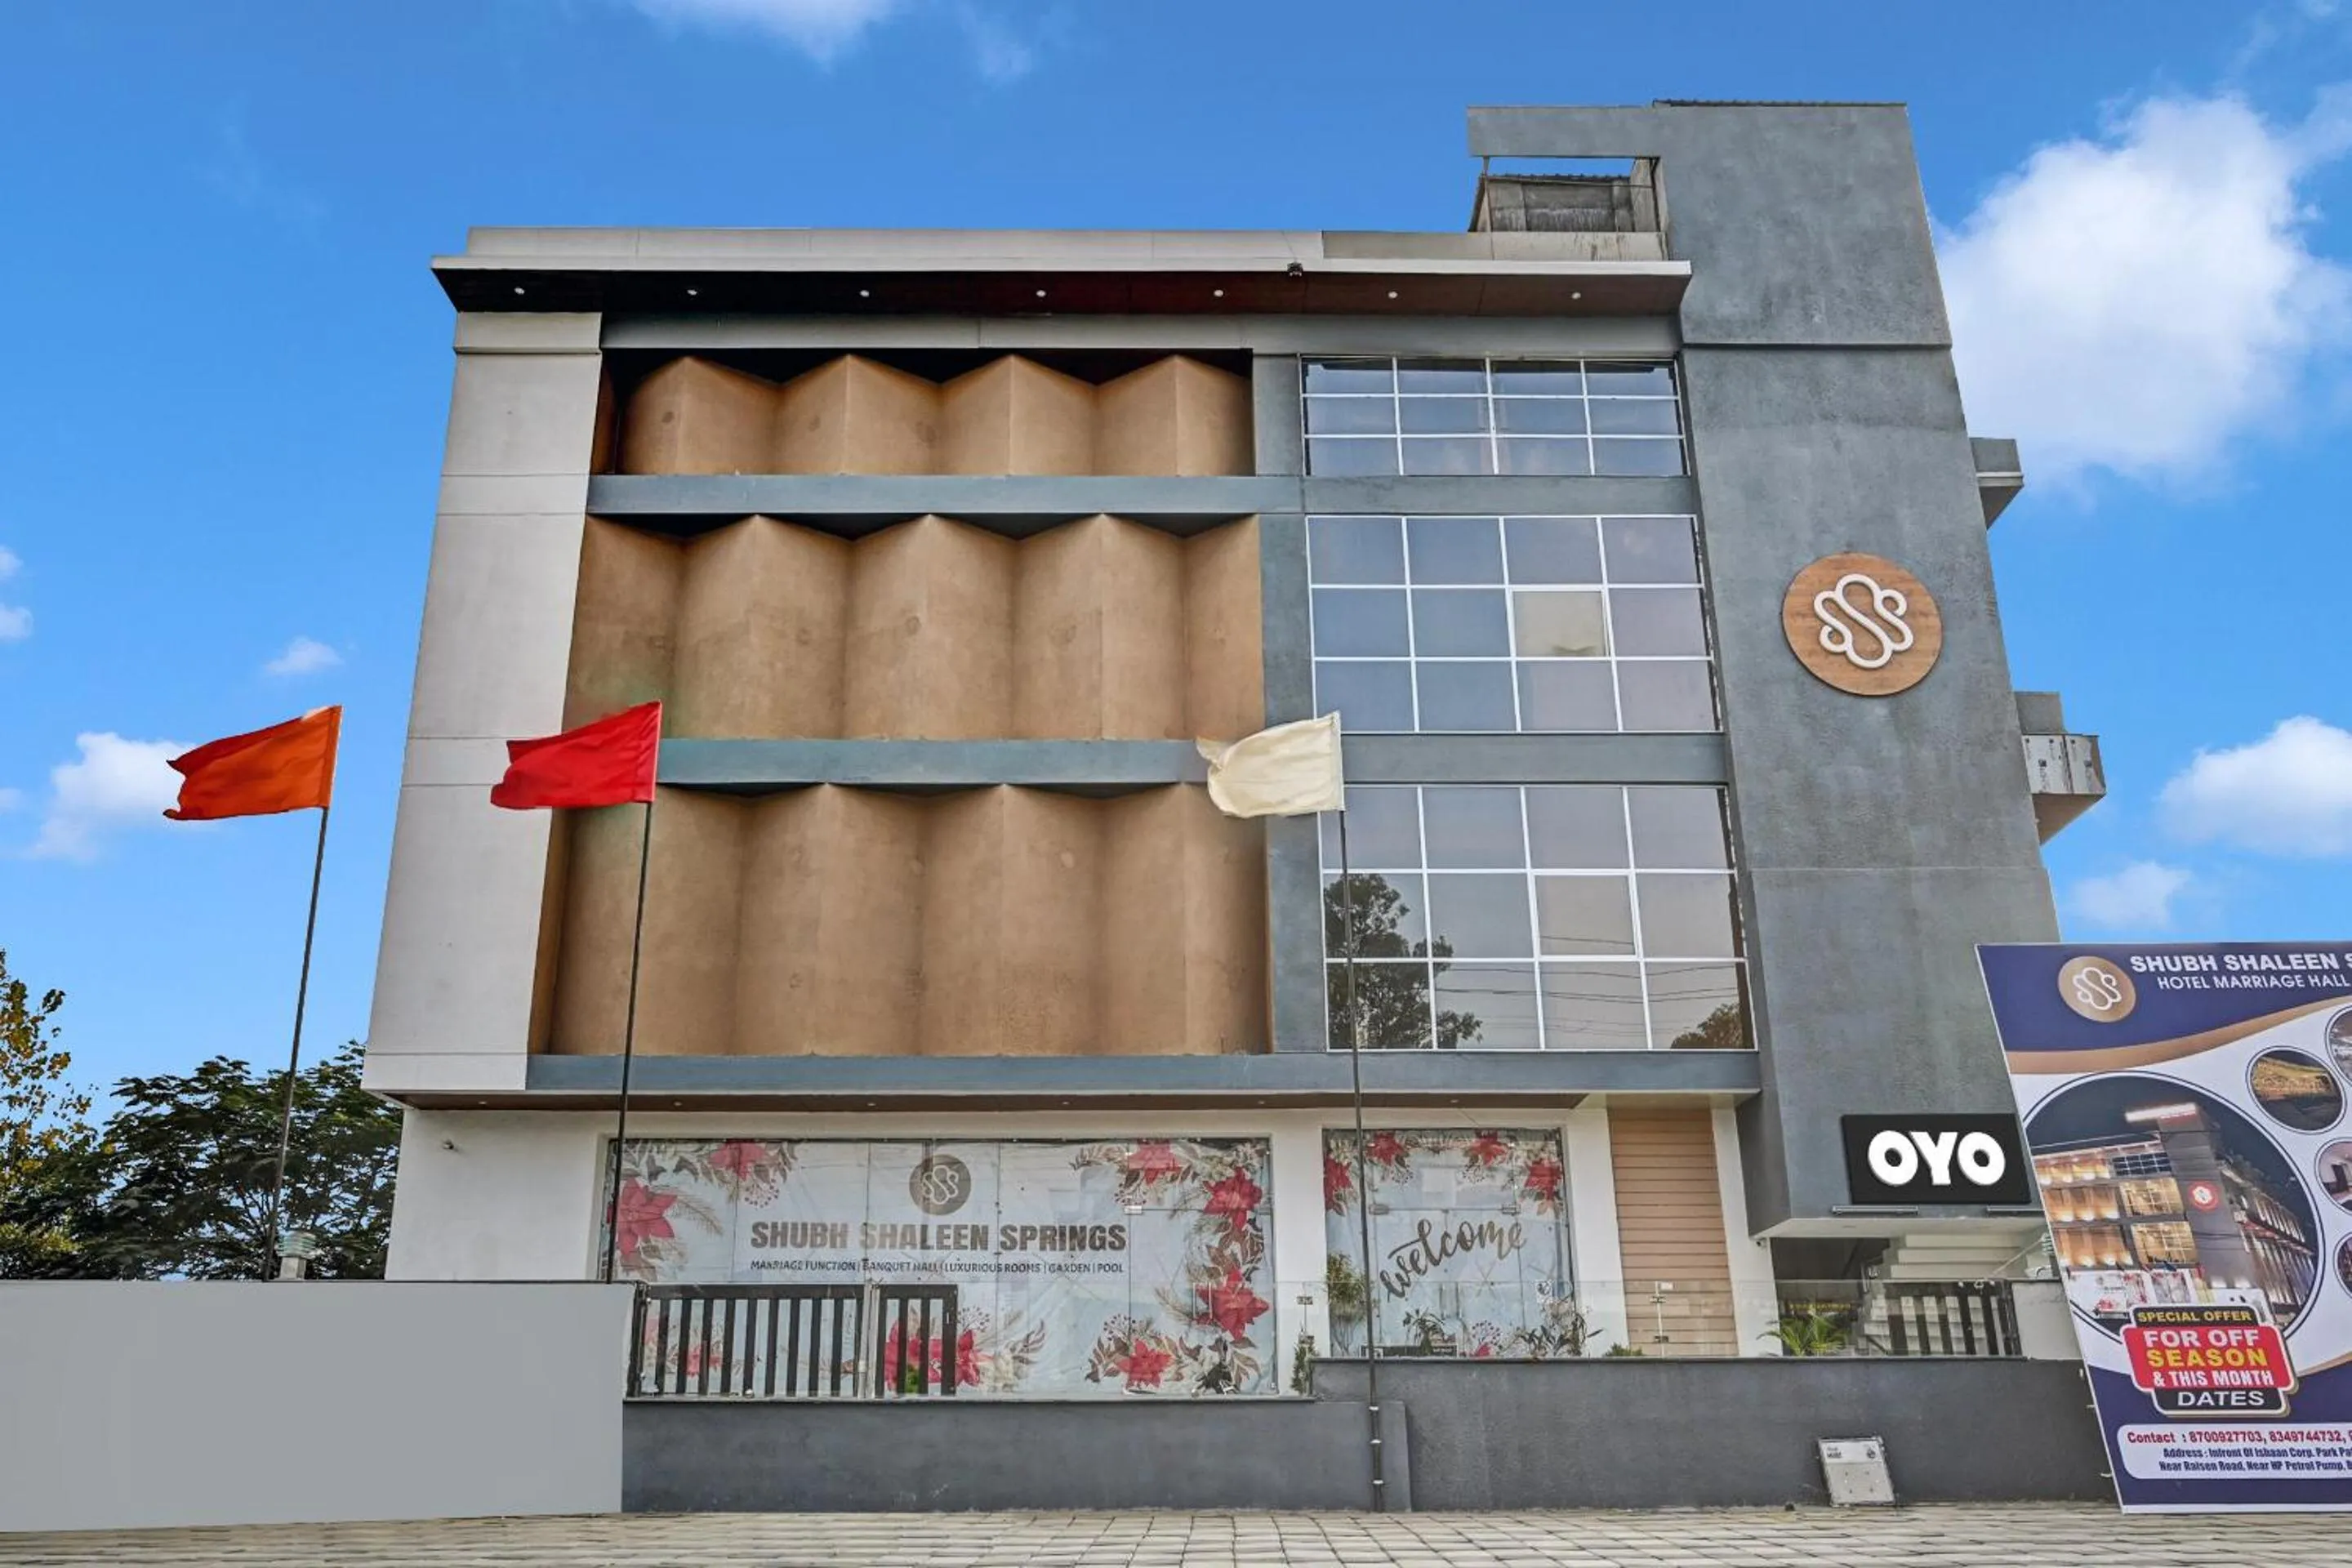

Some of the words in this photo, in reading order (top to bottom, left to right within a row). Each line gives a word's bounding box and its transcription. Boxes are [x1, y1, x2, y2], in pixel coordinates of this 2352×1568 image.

[2131, 955, 2218, 972] SHUBH
[2223, 953, 2340, 971] SHALEEN
[2158, 976, 2210, 990] HOTEL
[2214, 975, 2304, 989] MARRIAGE
[2308, 974, 2351, 987] HALL
[1868, 1130, 2006, 1187] OYO
[751, 1222, 849, 1250] SHUBH
[859, 1223, 989, 1251] SHALEEN
[1000, 1224, 1127, 1252] SPRINGS
[804, 1261, 857, 1272] FUNCTION
[862, 1261, 911, 1272] BANQUET
[944, 1263, 1002, 1273] LUXURIOUS
[1004, 1263, 1041, 1273] ROOMS
[1049, 1263, 1091, 1273] GARDEN
[1098, 1263, 1125, 1273] POOL
[1379, 1218, 1527, 1303] welcome
[2137, 1312, 2200, 1322] SPECIAL
[2204, 1310, 2252, 1321] OFFER
[2143, 1330, 2201, 1348] FOR
[2207, 1330, 2259, 1347] OFF
[2146, 1348, 2268, 1367] SEASON
[2153, 1371, 2165, 1387] &
[2167, 1370, 2208, 1386] THIS
[2212, 1370, 2274, 1386] MONTH
[2176, 1391, 2265, 1406] DATES
[2127, 1432, 2176, 1444] Contact
